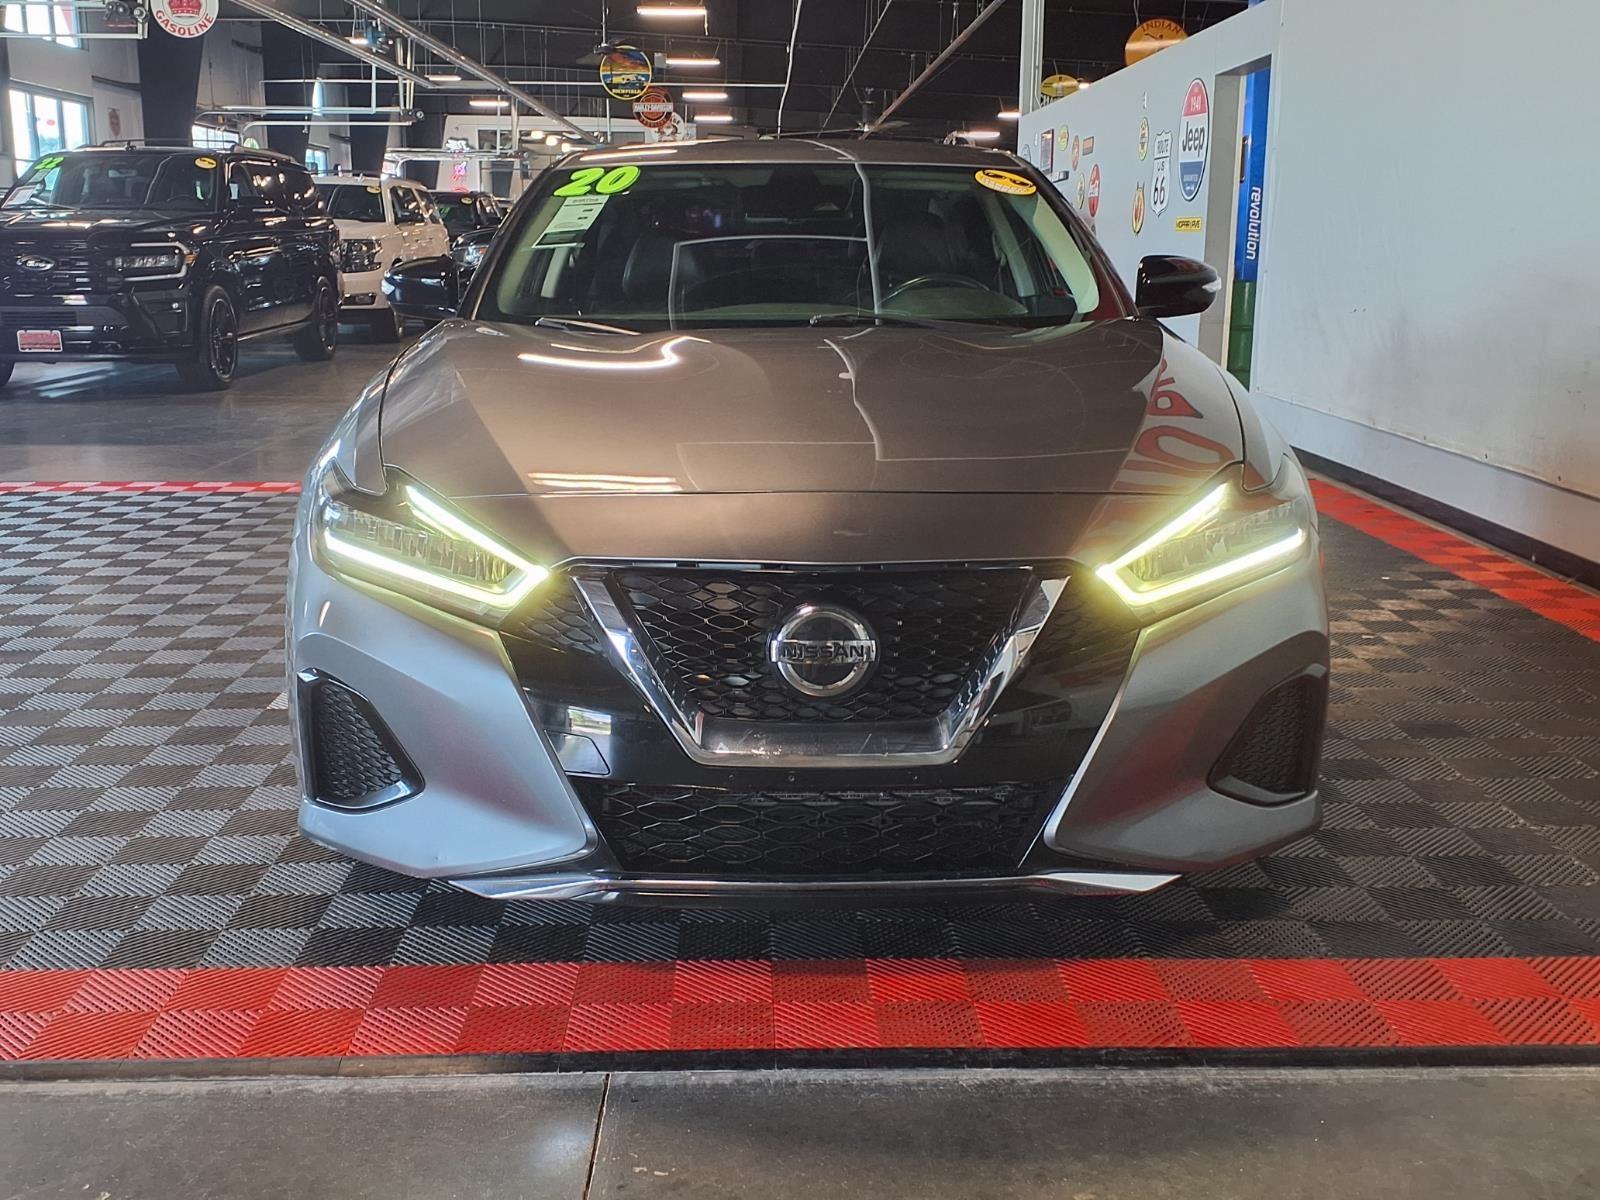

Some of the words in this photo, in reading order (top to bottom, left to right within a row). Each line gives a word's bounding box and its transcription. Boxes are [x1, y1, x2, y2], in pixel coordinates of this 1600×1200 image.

[155, 10, 214, 36] GASOLINE
[1141, 20, 1181, 34] INDIAN
[1182, 120, 1205, 157] Jeep
[553, 166, 640, 196] 20
[1153, 175, 1166, 205] 66
[1245, 186, 1262, 260] revolution
[783, 643, 864, 659] NISSAN
